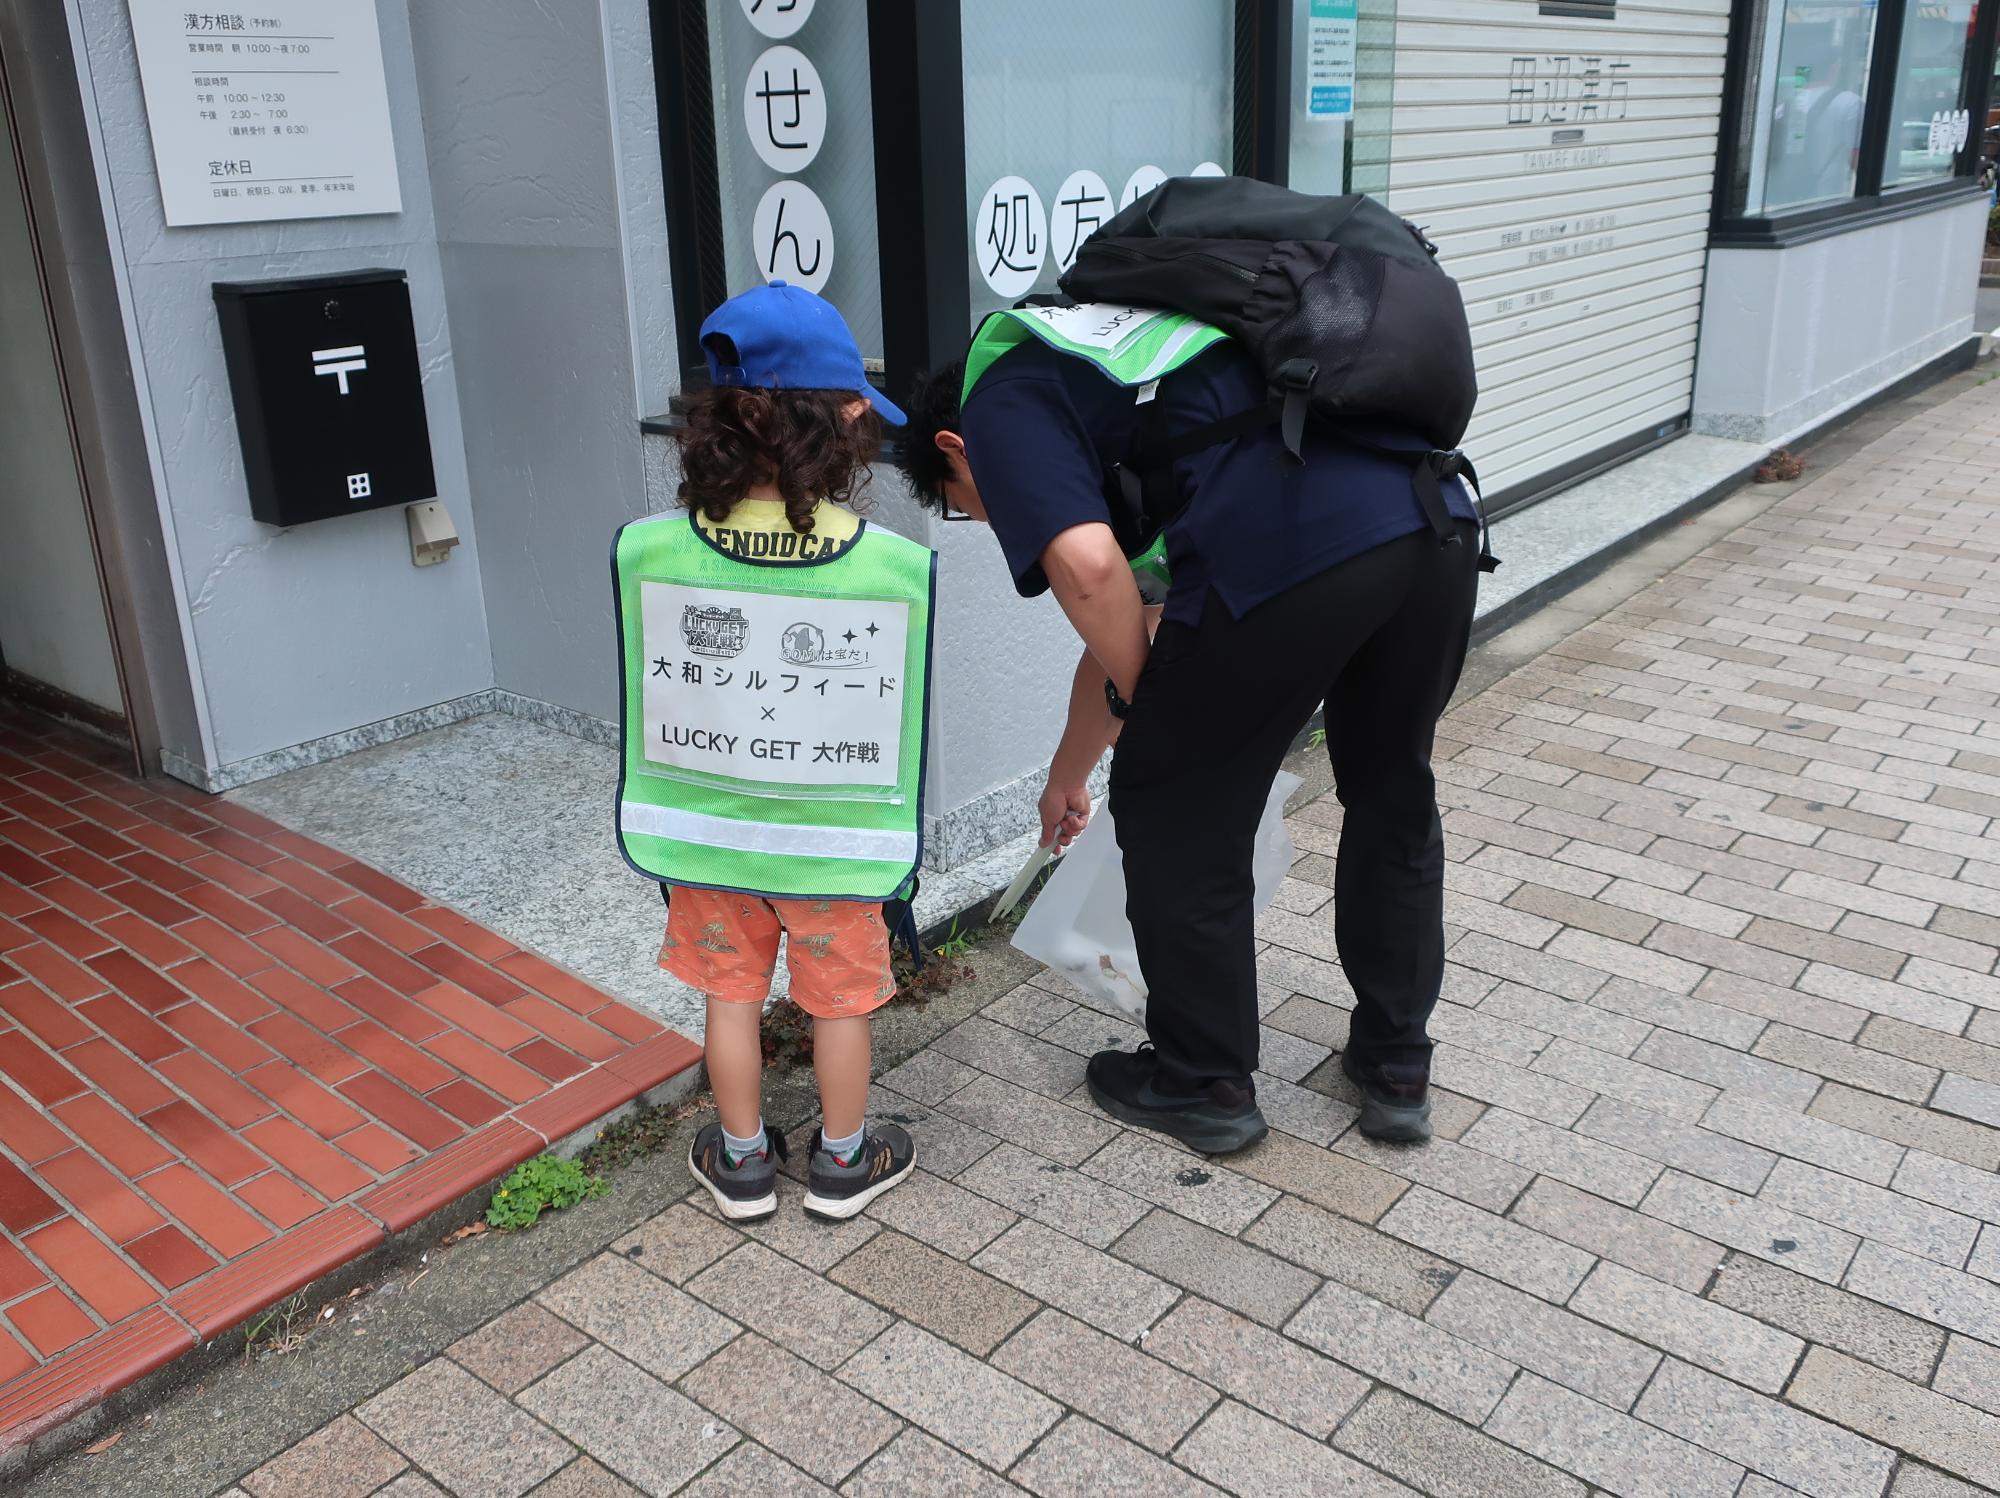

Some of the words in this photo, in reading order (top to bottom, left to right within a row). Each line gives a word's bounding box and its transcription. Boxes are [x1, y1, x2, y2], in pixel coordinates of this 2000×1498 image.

[184, 14, 245, 30] 漢方相談
[188, 43, 224, 53] 営業時間
[194, 77, 229, 87] 相談時間
[208, 160, 252, 176] 定休日
[1092, 308, 1145, 337] LUCK
[700, 527, 797, 558] ENDID
[652, 656, 896, 698] 大和シルフィード
[661, 724, 739, 755] LUCKY
[750, 738, 802, 761] GET
[811, 741, 880, 764] 大作戦
